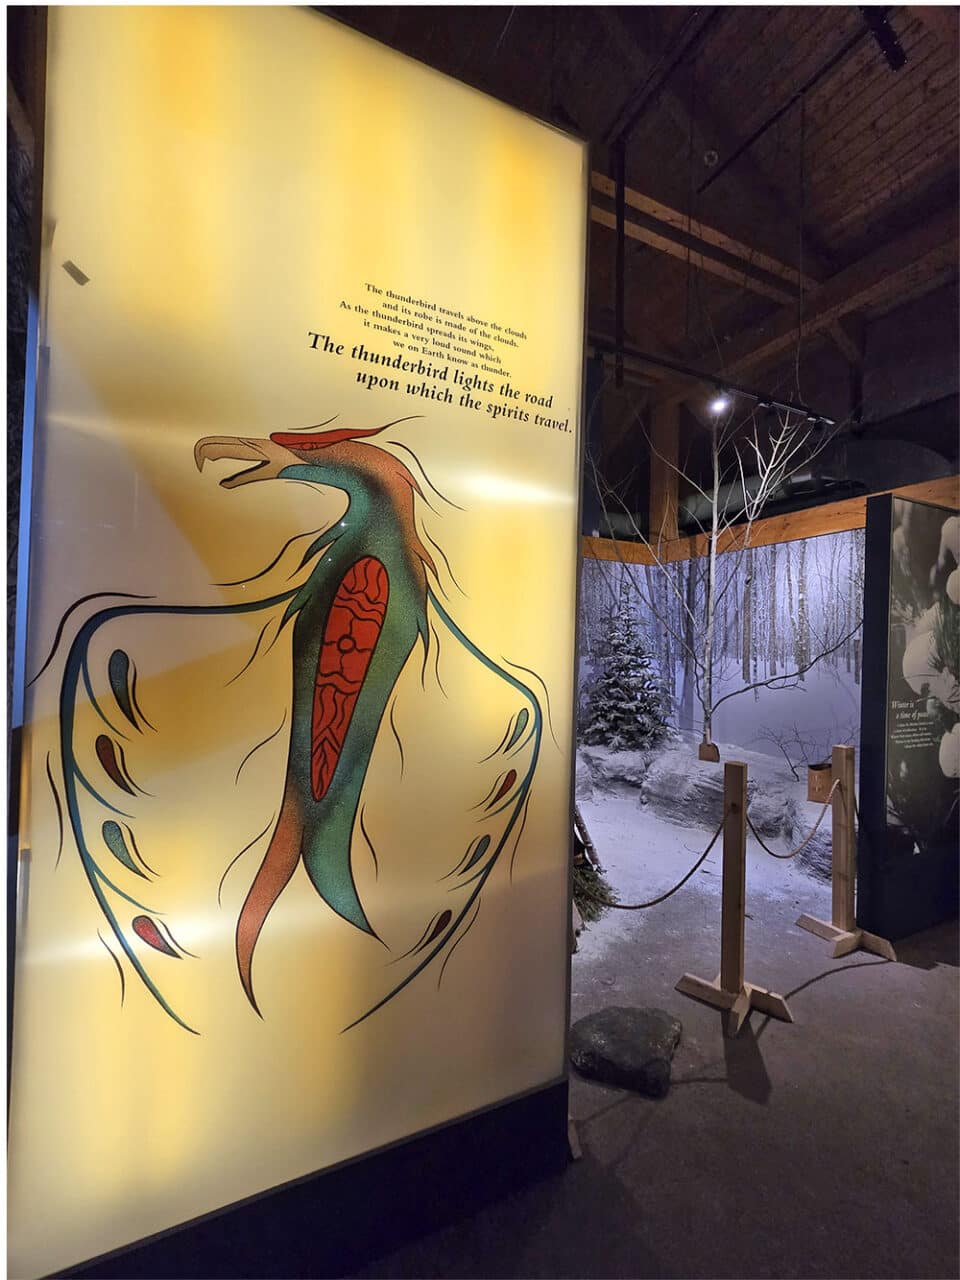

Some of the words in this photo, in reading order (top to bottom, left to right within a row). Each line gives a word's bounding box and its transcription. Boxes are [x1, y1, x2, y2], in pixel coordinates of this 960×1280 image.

[339, 300, 352, 310] As
[354, 305, 369, 315] the
[372, 310, 424, 330] thunderbird
[426, 327, 456, 339] spreads
[458, 332, 468, 343] its
[365, 283, 383, 295] The
[386, 291, 437, 312] thunderbird
[439, 307, 465, 320] travels
[467, 315, 488, 327] above
[490, 322, 502, 331] the
[504, 326, 528, 339] clouds
[308, 333, 345, 356] The
[351, 346, 448, 382] thunderbird
[453, 369, 495, 394] lights
[500, 383, 521, 400] the
[525, 393, 553, 408] road
[356, 372, 399, 391] upon
[406, 380, 453, 404] which
[459, 392, 482, 411] the
[486, 400, 530, 422] spirits
[534, 412, 573, 432] travel.
